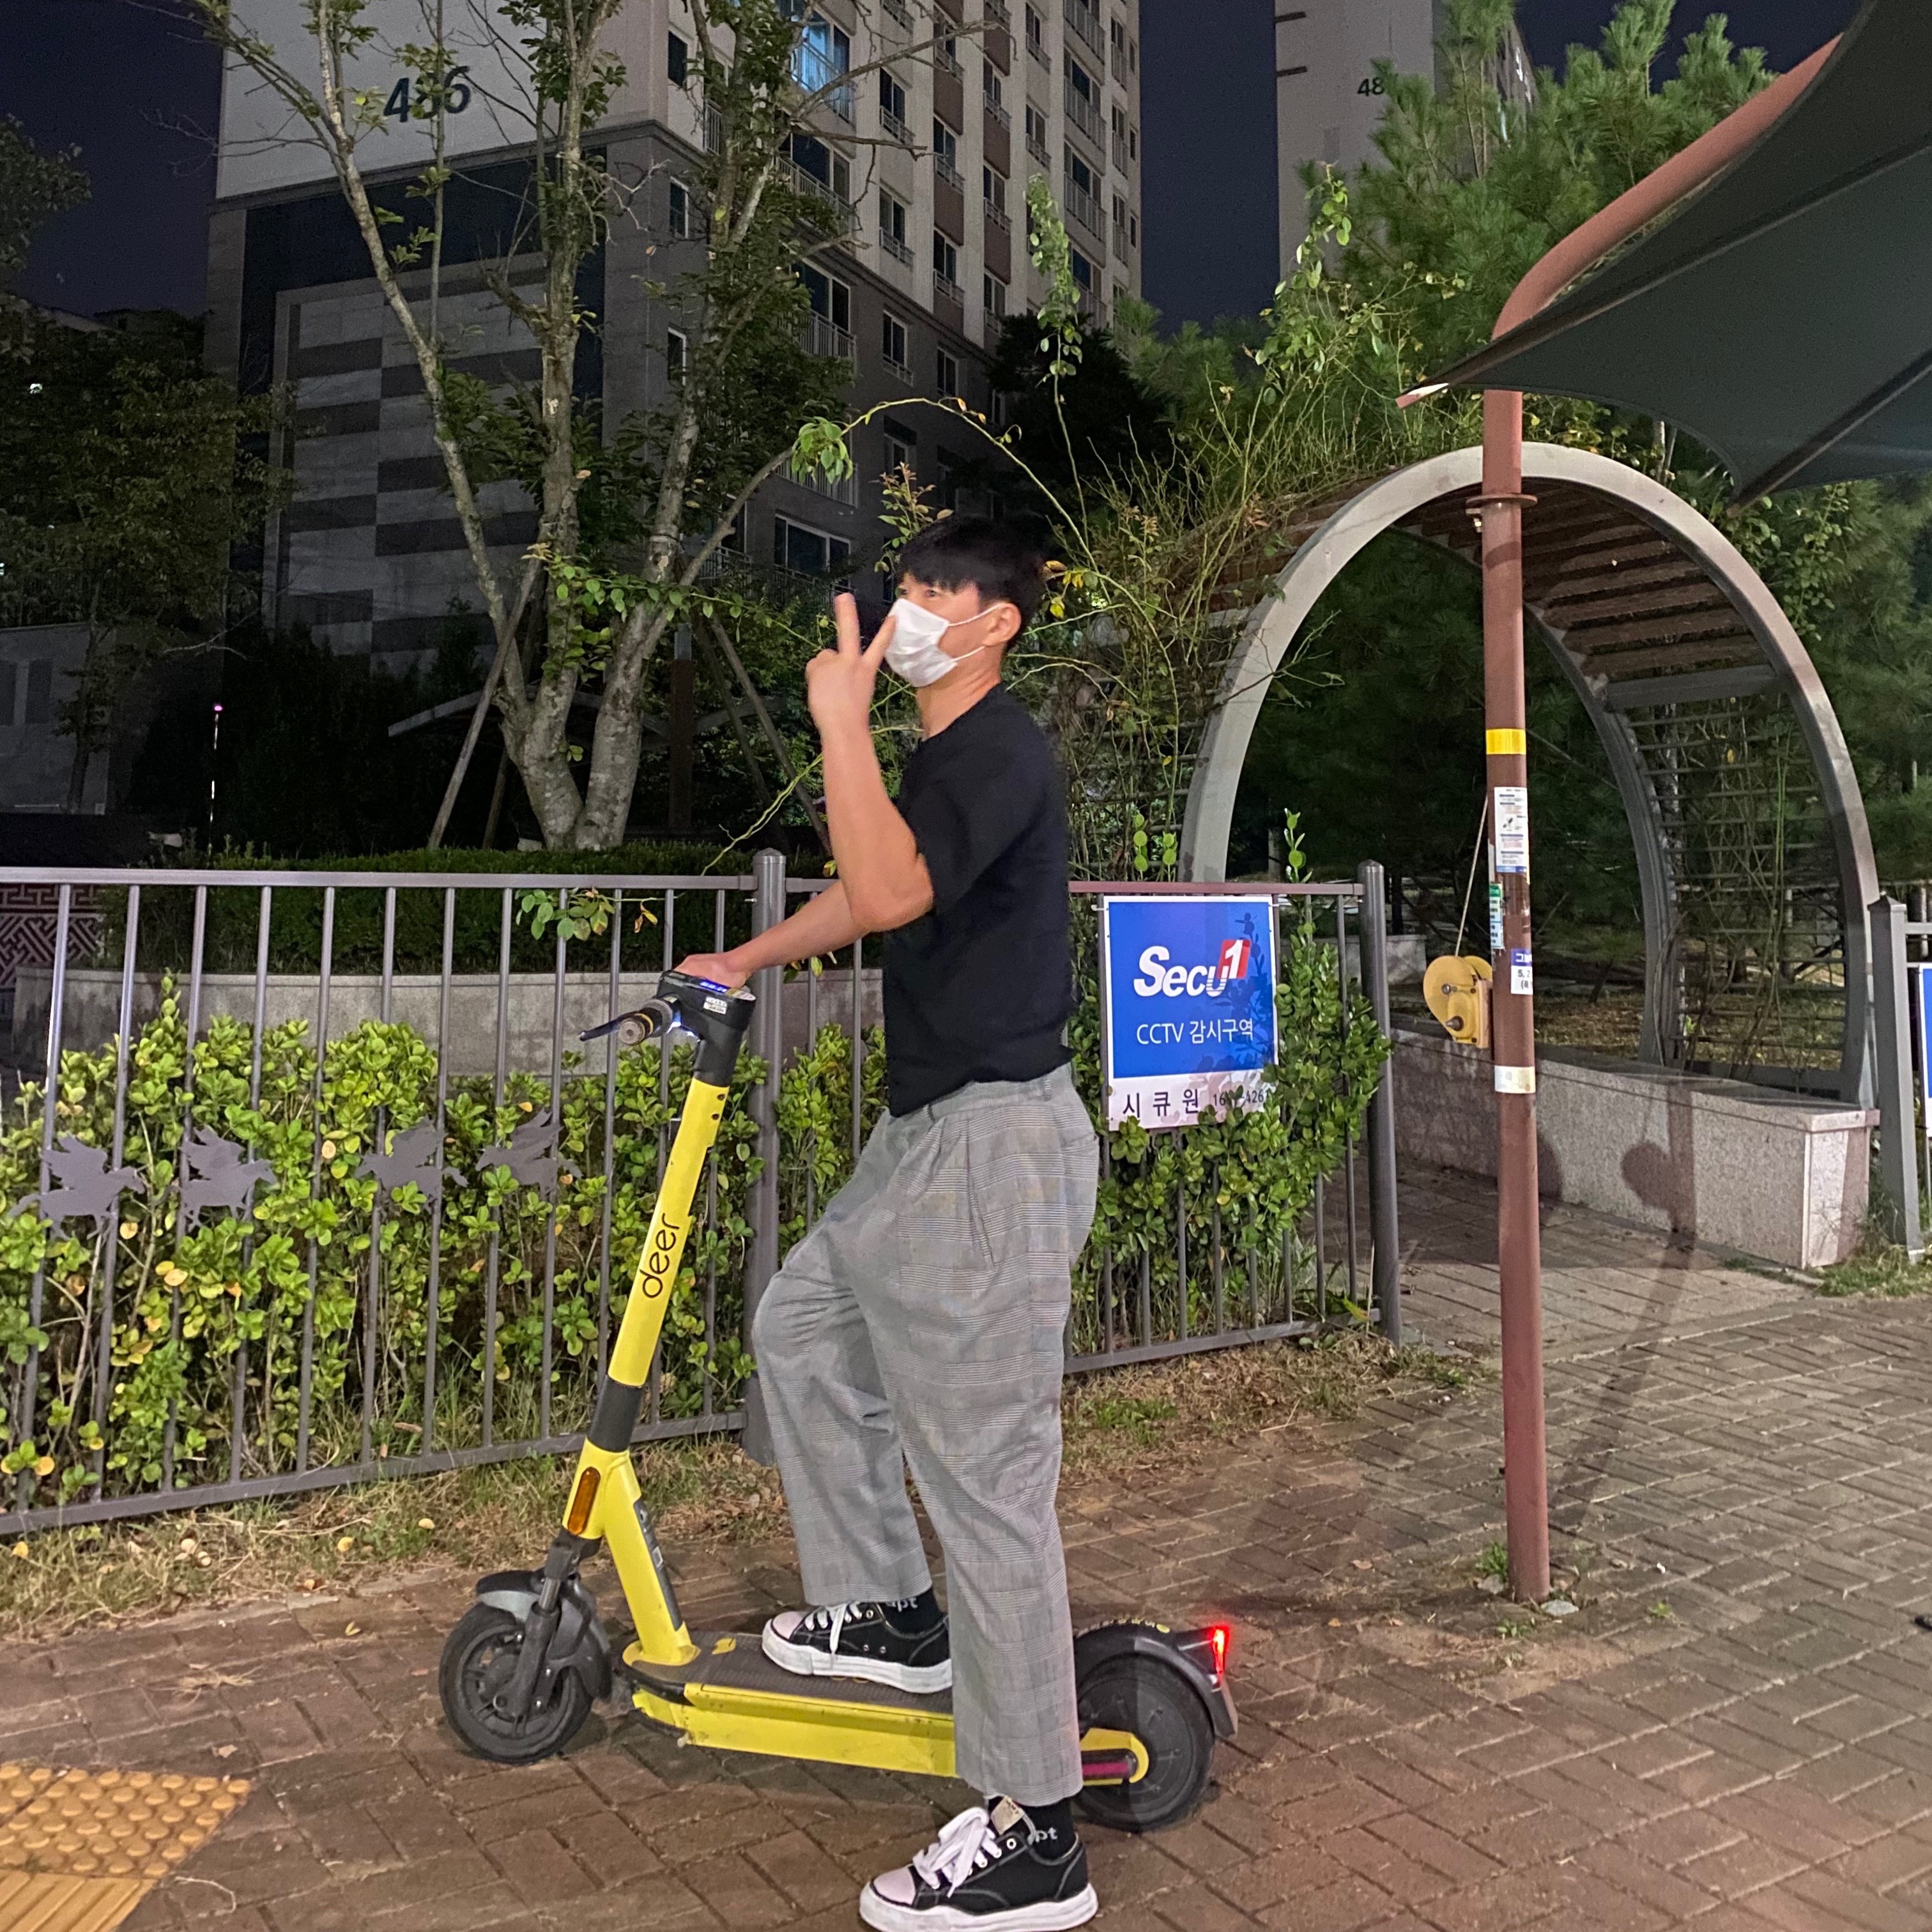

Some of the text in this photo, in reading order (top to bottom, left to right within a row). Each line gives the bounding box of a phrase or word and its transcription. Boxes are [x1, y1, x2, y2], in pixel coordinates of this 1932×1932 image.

[383, 65, 471, 123] 486
[1357, 77, 1385, 96] 48
[1137, 1018, 1254, 1045] CCTV 감시구역
[640, 1213, 680, 1298] deer
